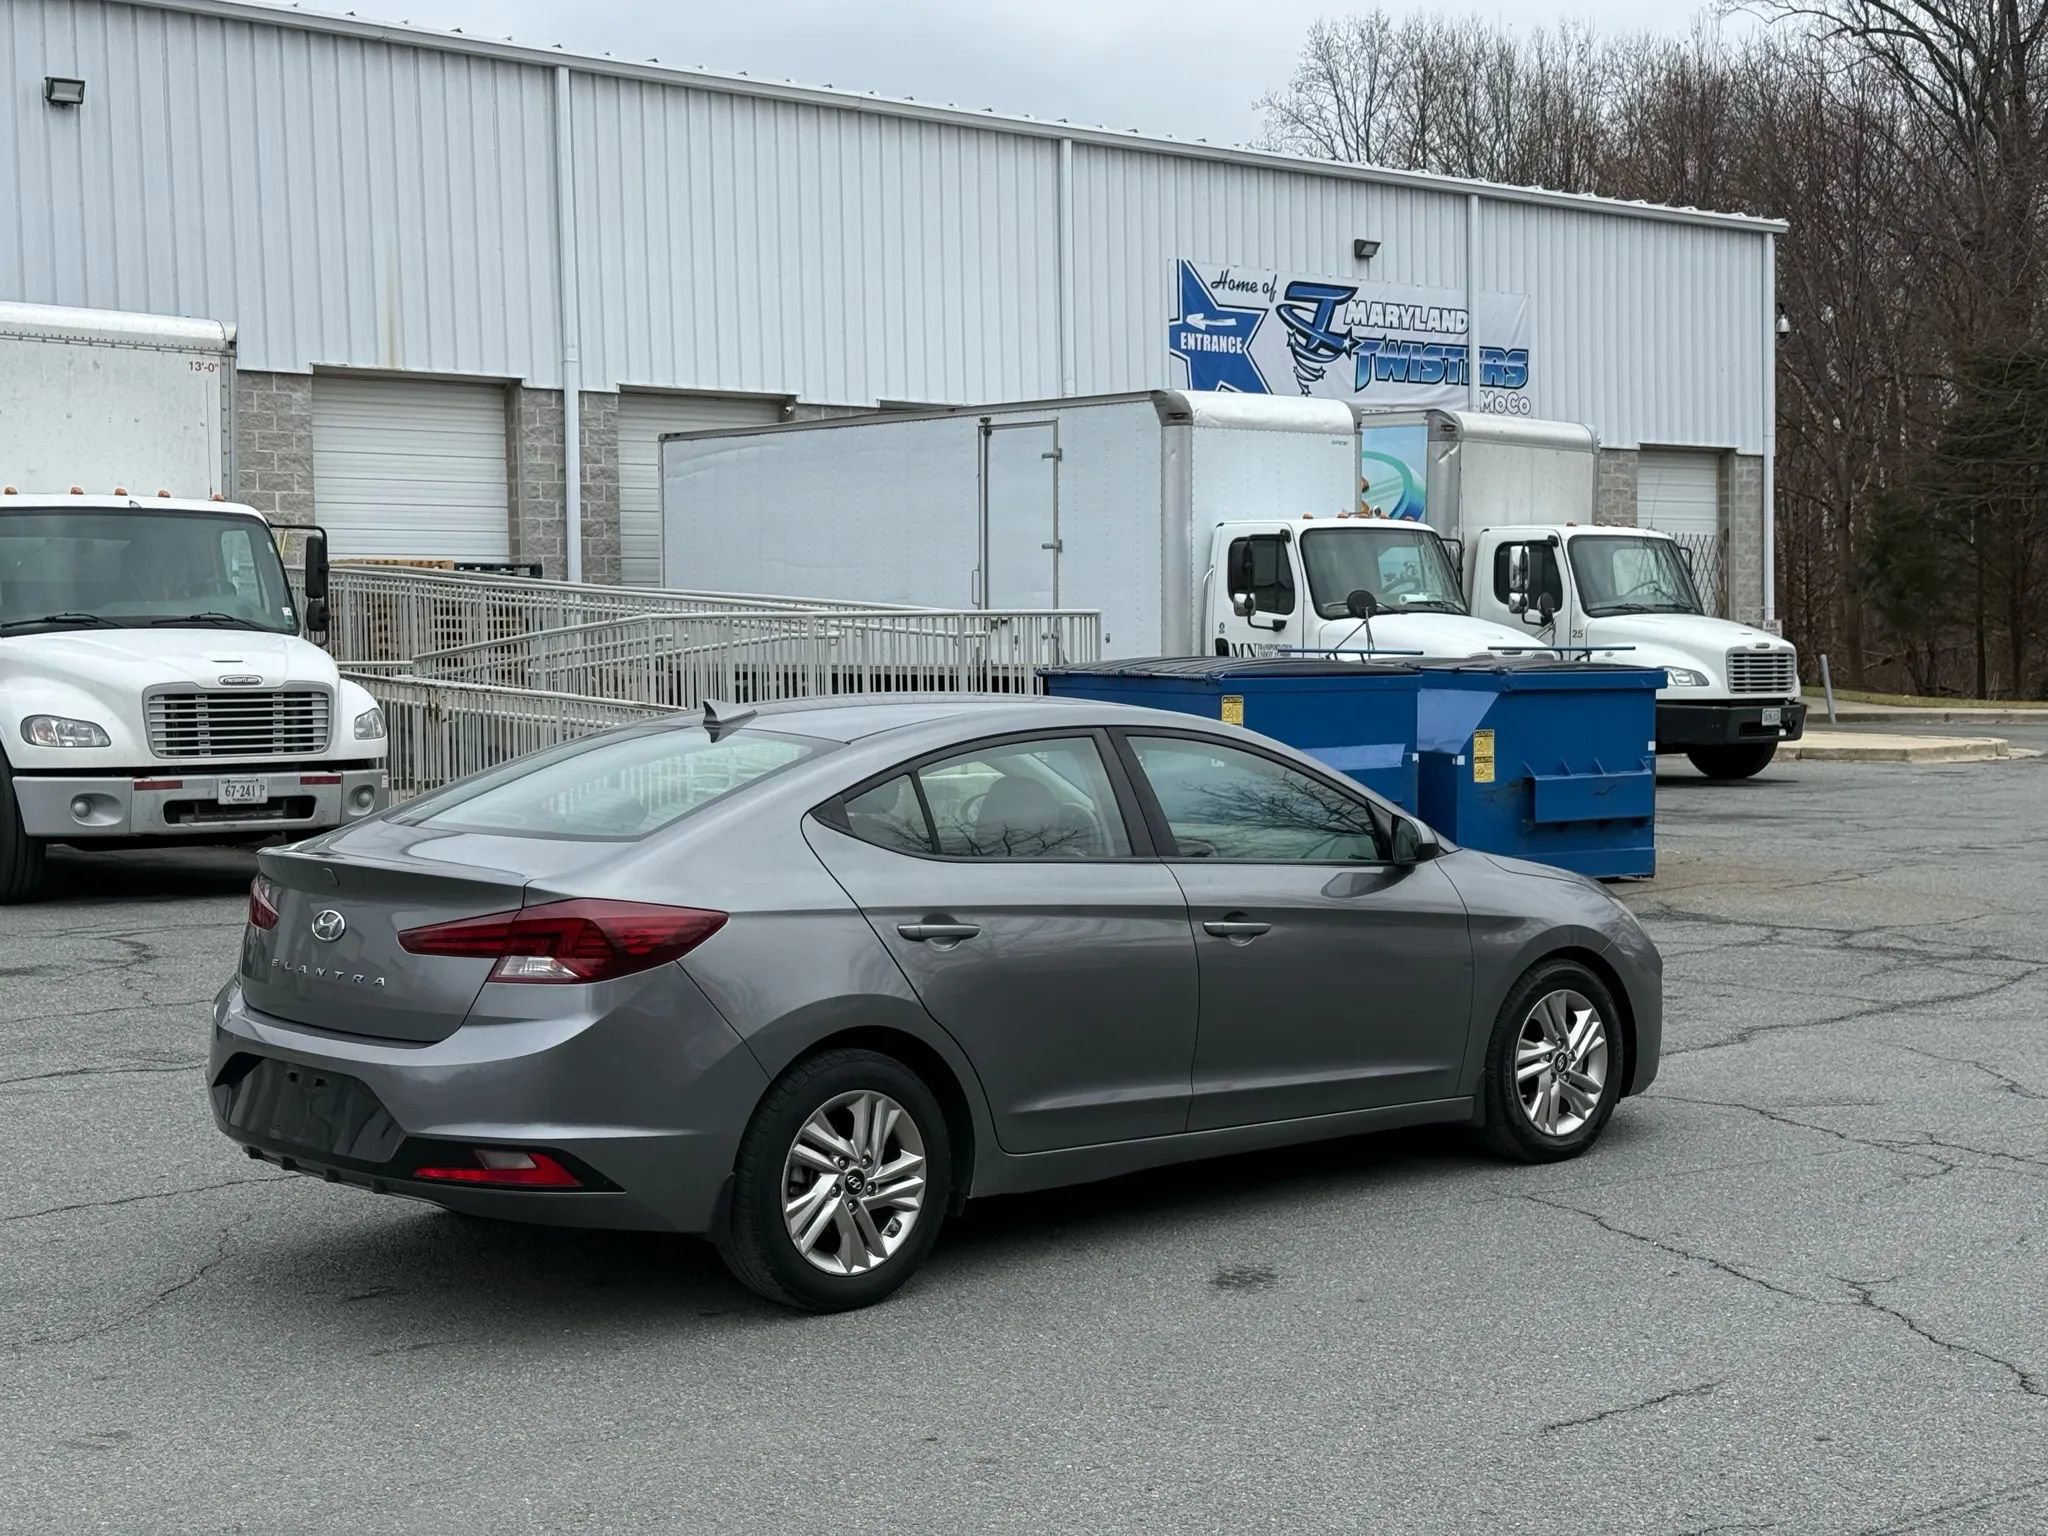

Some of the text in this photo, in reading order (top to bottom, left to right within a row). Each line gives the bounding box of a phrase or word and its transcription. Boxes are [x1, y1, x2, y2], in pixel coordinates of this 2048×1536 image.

[1210, 268, 1277, 303] Home of
[1344, 300, 1469, 335] MARYLAND
[1180, 332, 1243, 354] ENTRANCE
[188, 361, 219, 373] 13'-0"
[1571, 629, 1584, 639] 25
[225, 784, 256, 798] 67-241
[271, 958, 386, 987] ELANTRA
